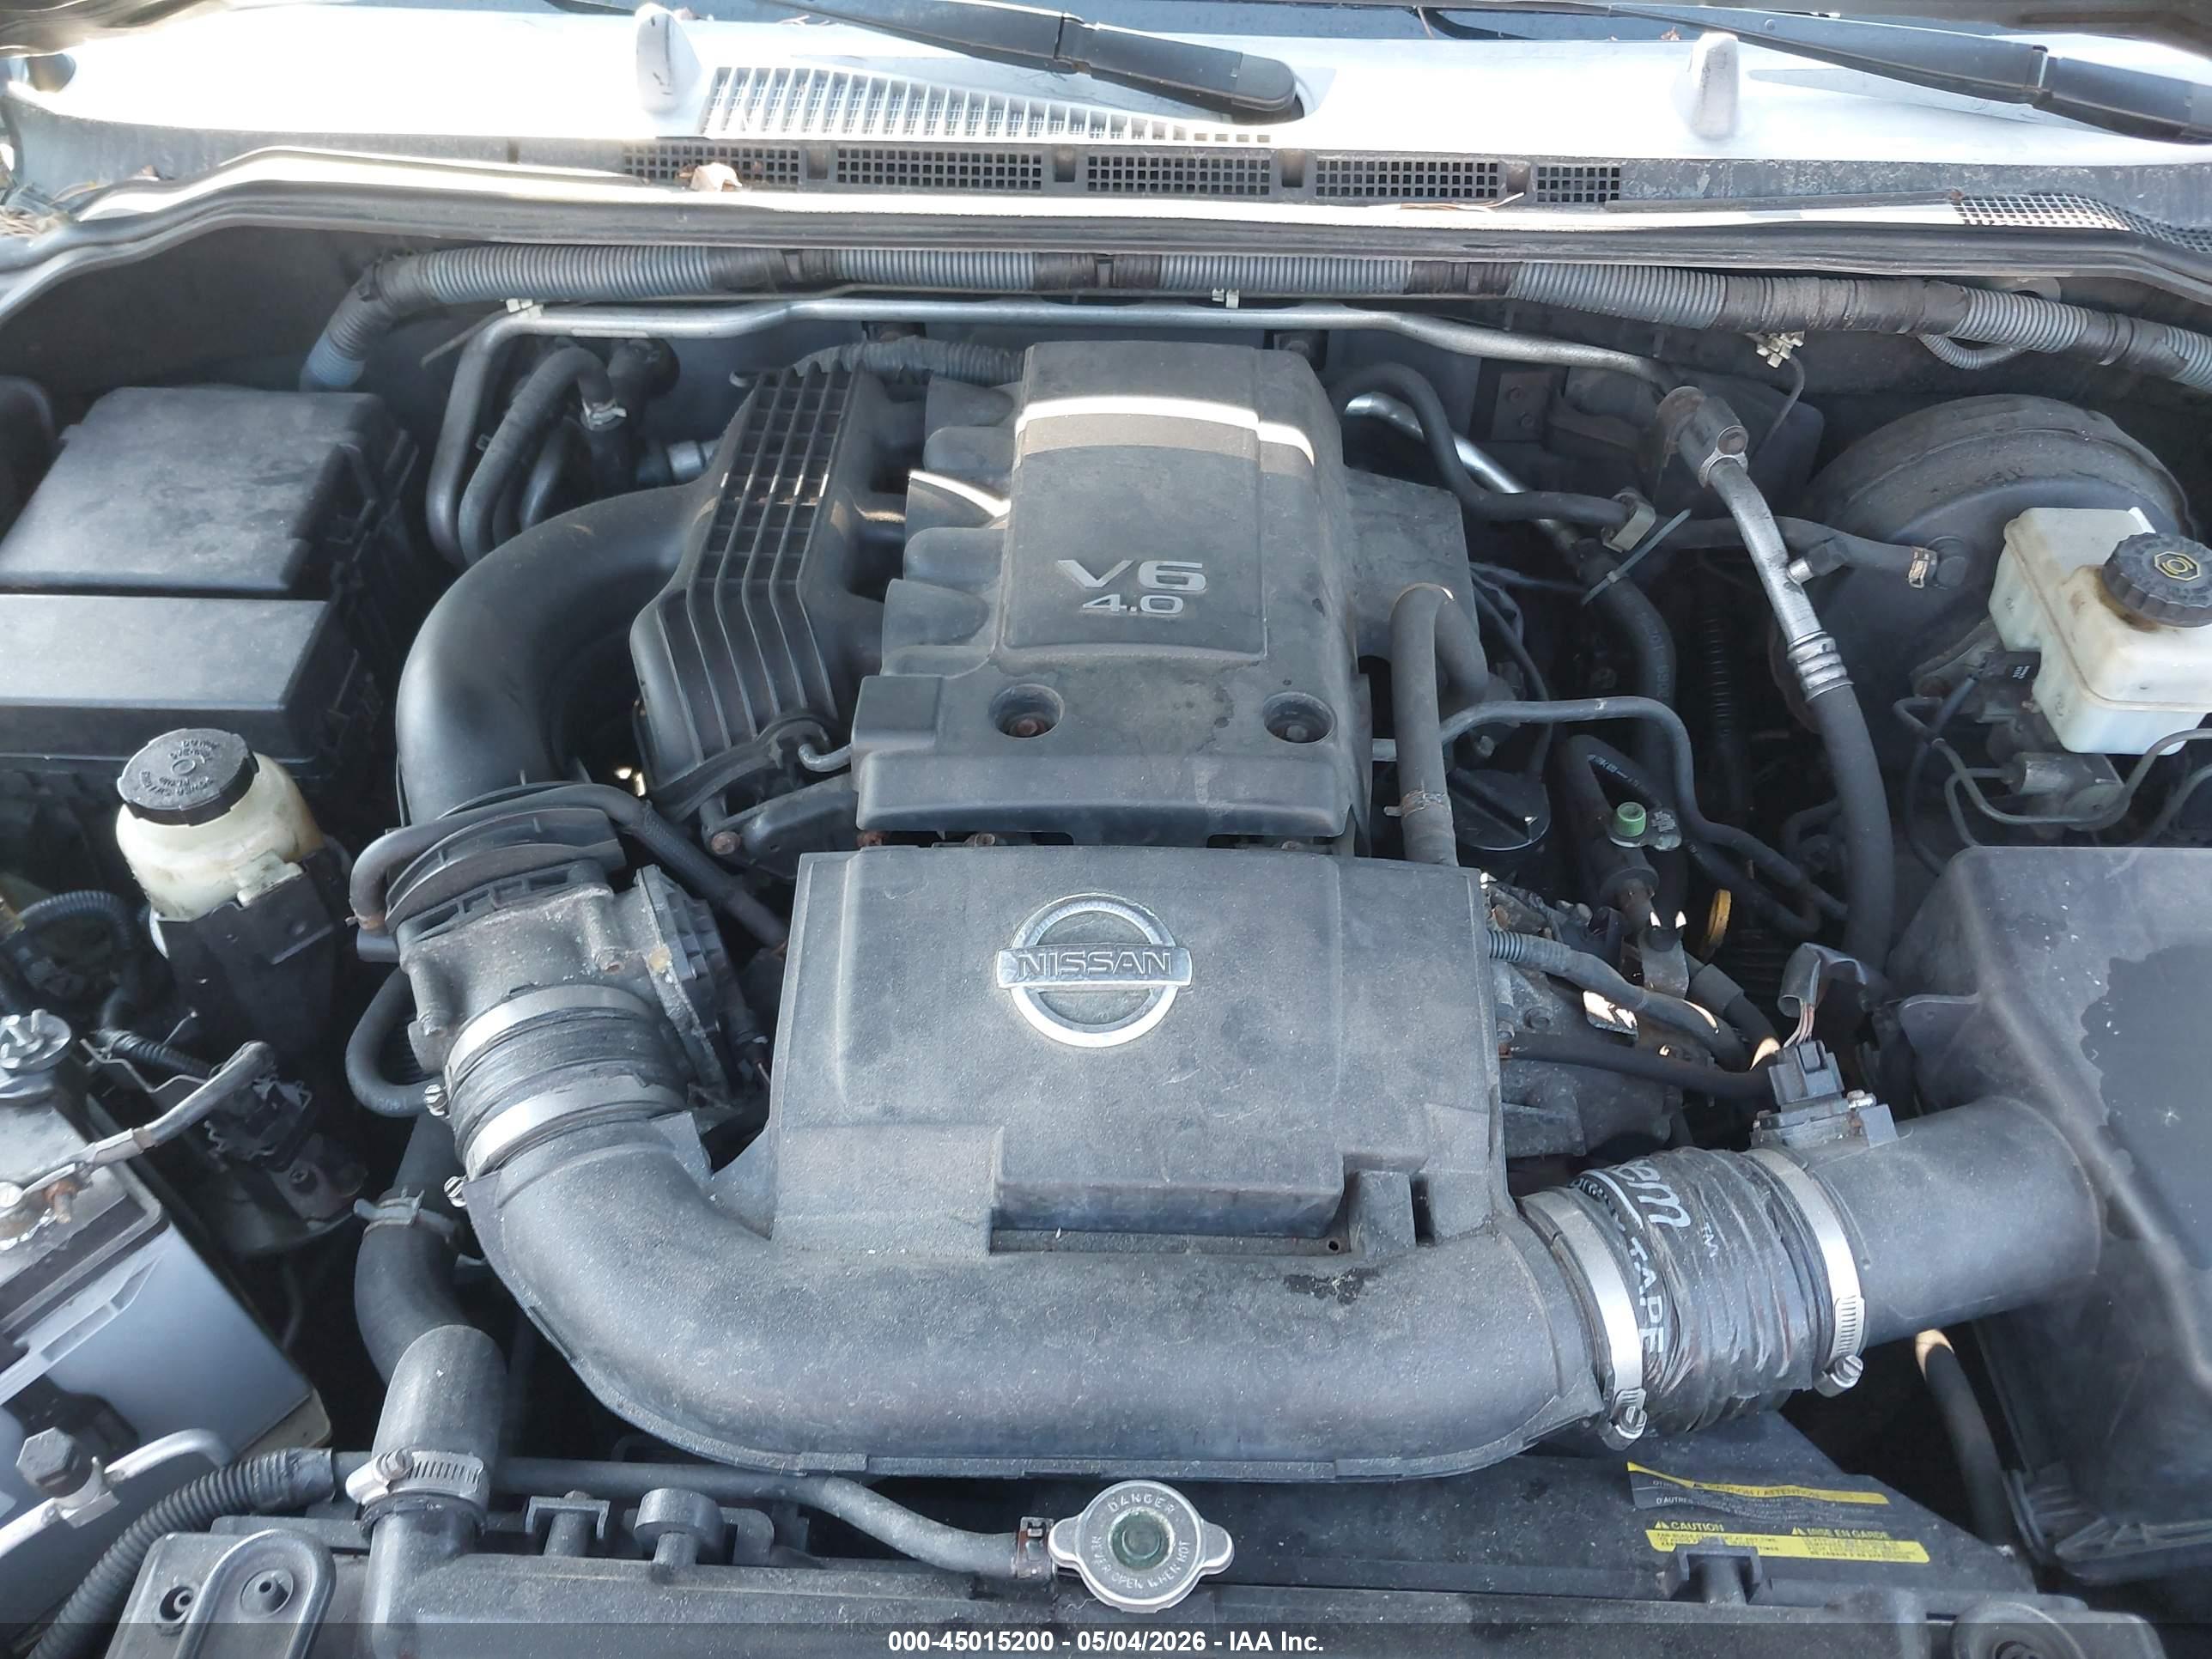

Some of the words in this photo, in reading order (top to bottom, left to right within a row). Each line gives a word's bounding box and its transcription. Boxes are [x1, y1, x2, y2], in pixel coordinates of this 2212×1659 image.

[1057, 559, 1206, 592] V6
[1083, 593, 1184, 614] 4.0
[1018, 951, 1171, 976] NISSAN
[1630, 1237, 1664, 1354] TAPE
[1107, 1493, 1176, 1513] DANGER
[1670, 1521, 1724, 1533] CAUTION
[1834, 1528, 1851, 1538] EN
[1111, 1571, 1143, 1589] OPEN
[1147, 1565, 1182, 1588] WHEN
[1177, 1540, 1191, 1563] HOT
